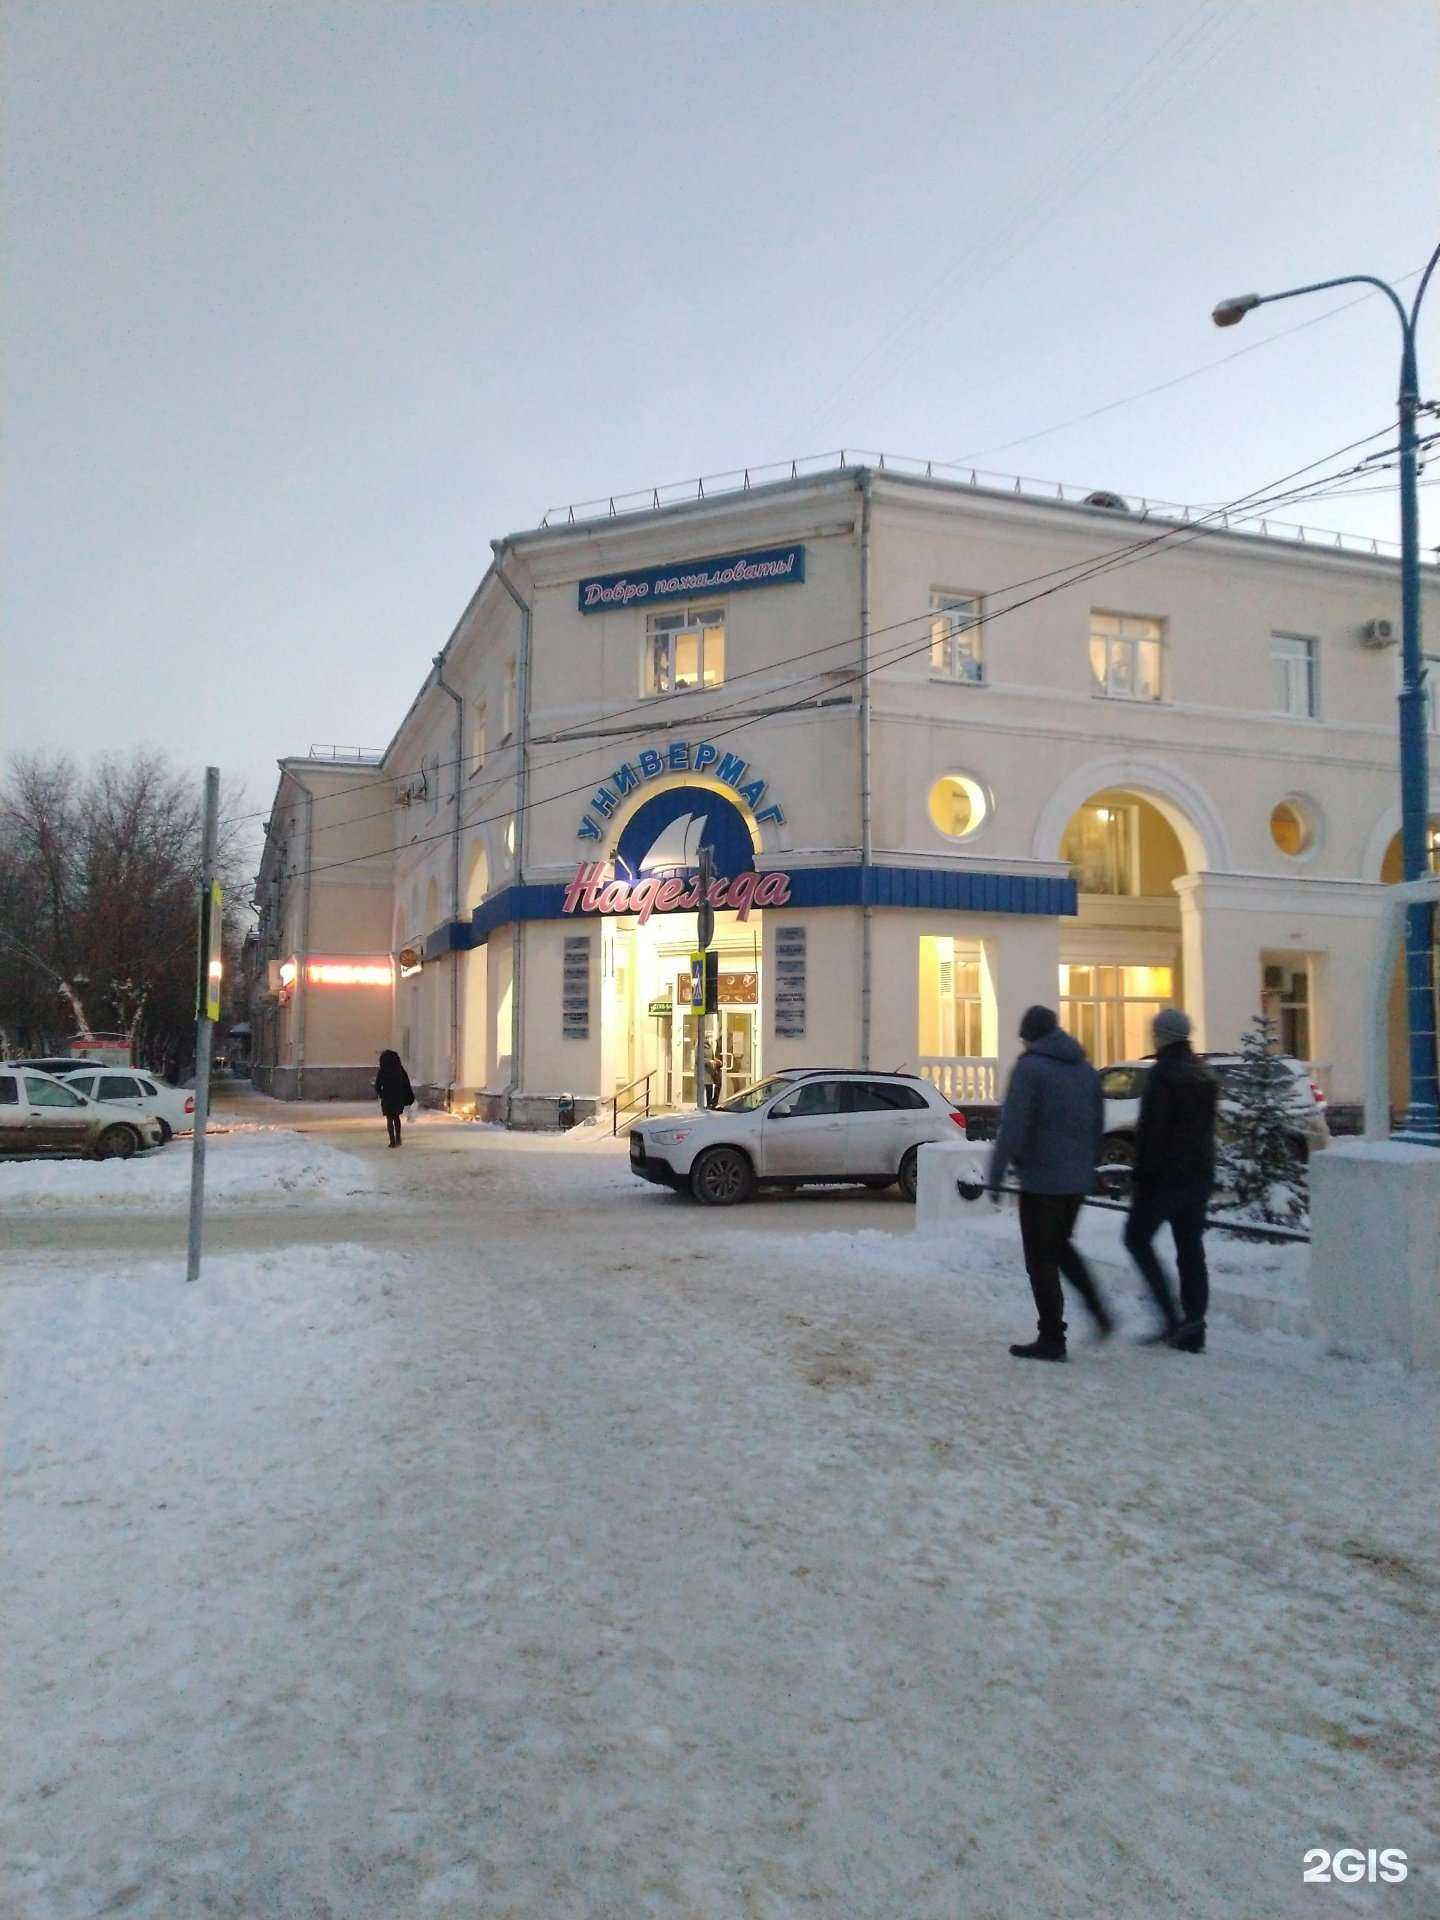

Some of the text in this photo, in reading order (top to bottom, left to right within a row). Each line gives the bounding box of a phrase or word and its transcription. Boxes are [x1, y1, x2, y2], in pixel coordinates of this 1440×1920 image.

[584, 553, 794, 605] Добро пожаловать!
[576, 741, 787, 842] УНИВЕРМАГ
[562, 860, 792, 925] Надежда
